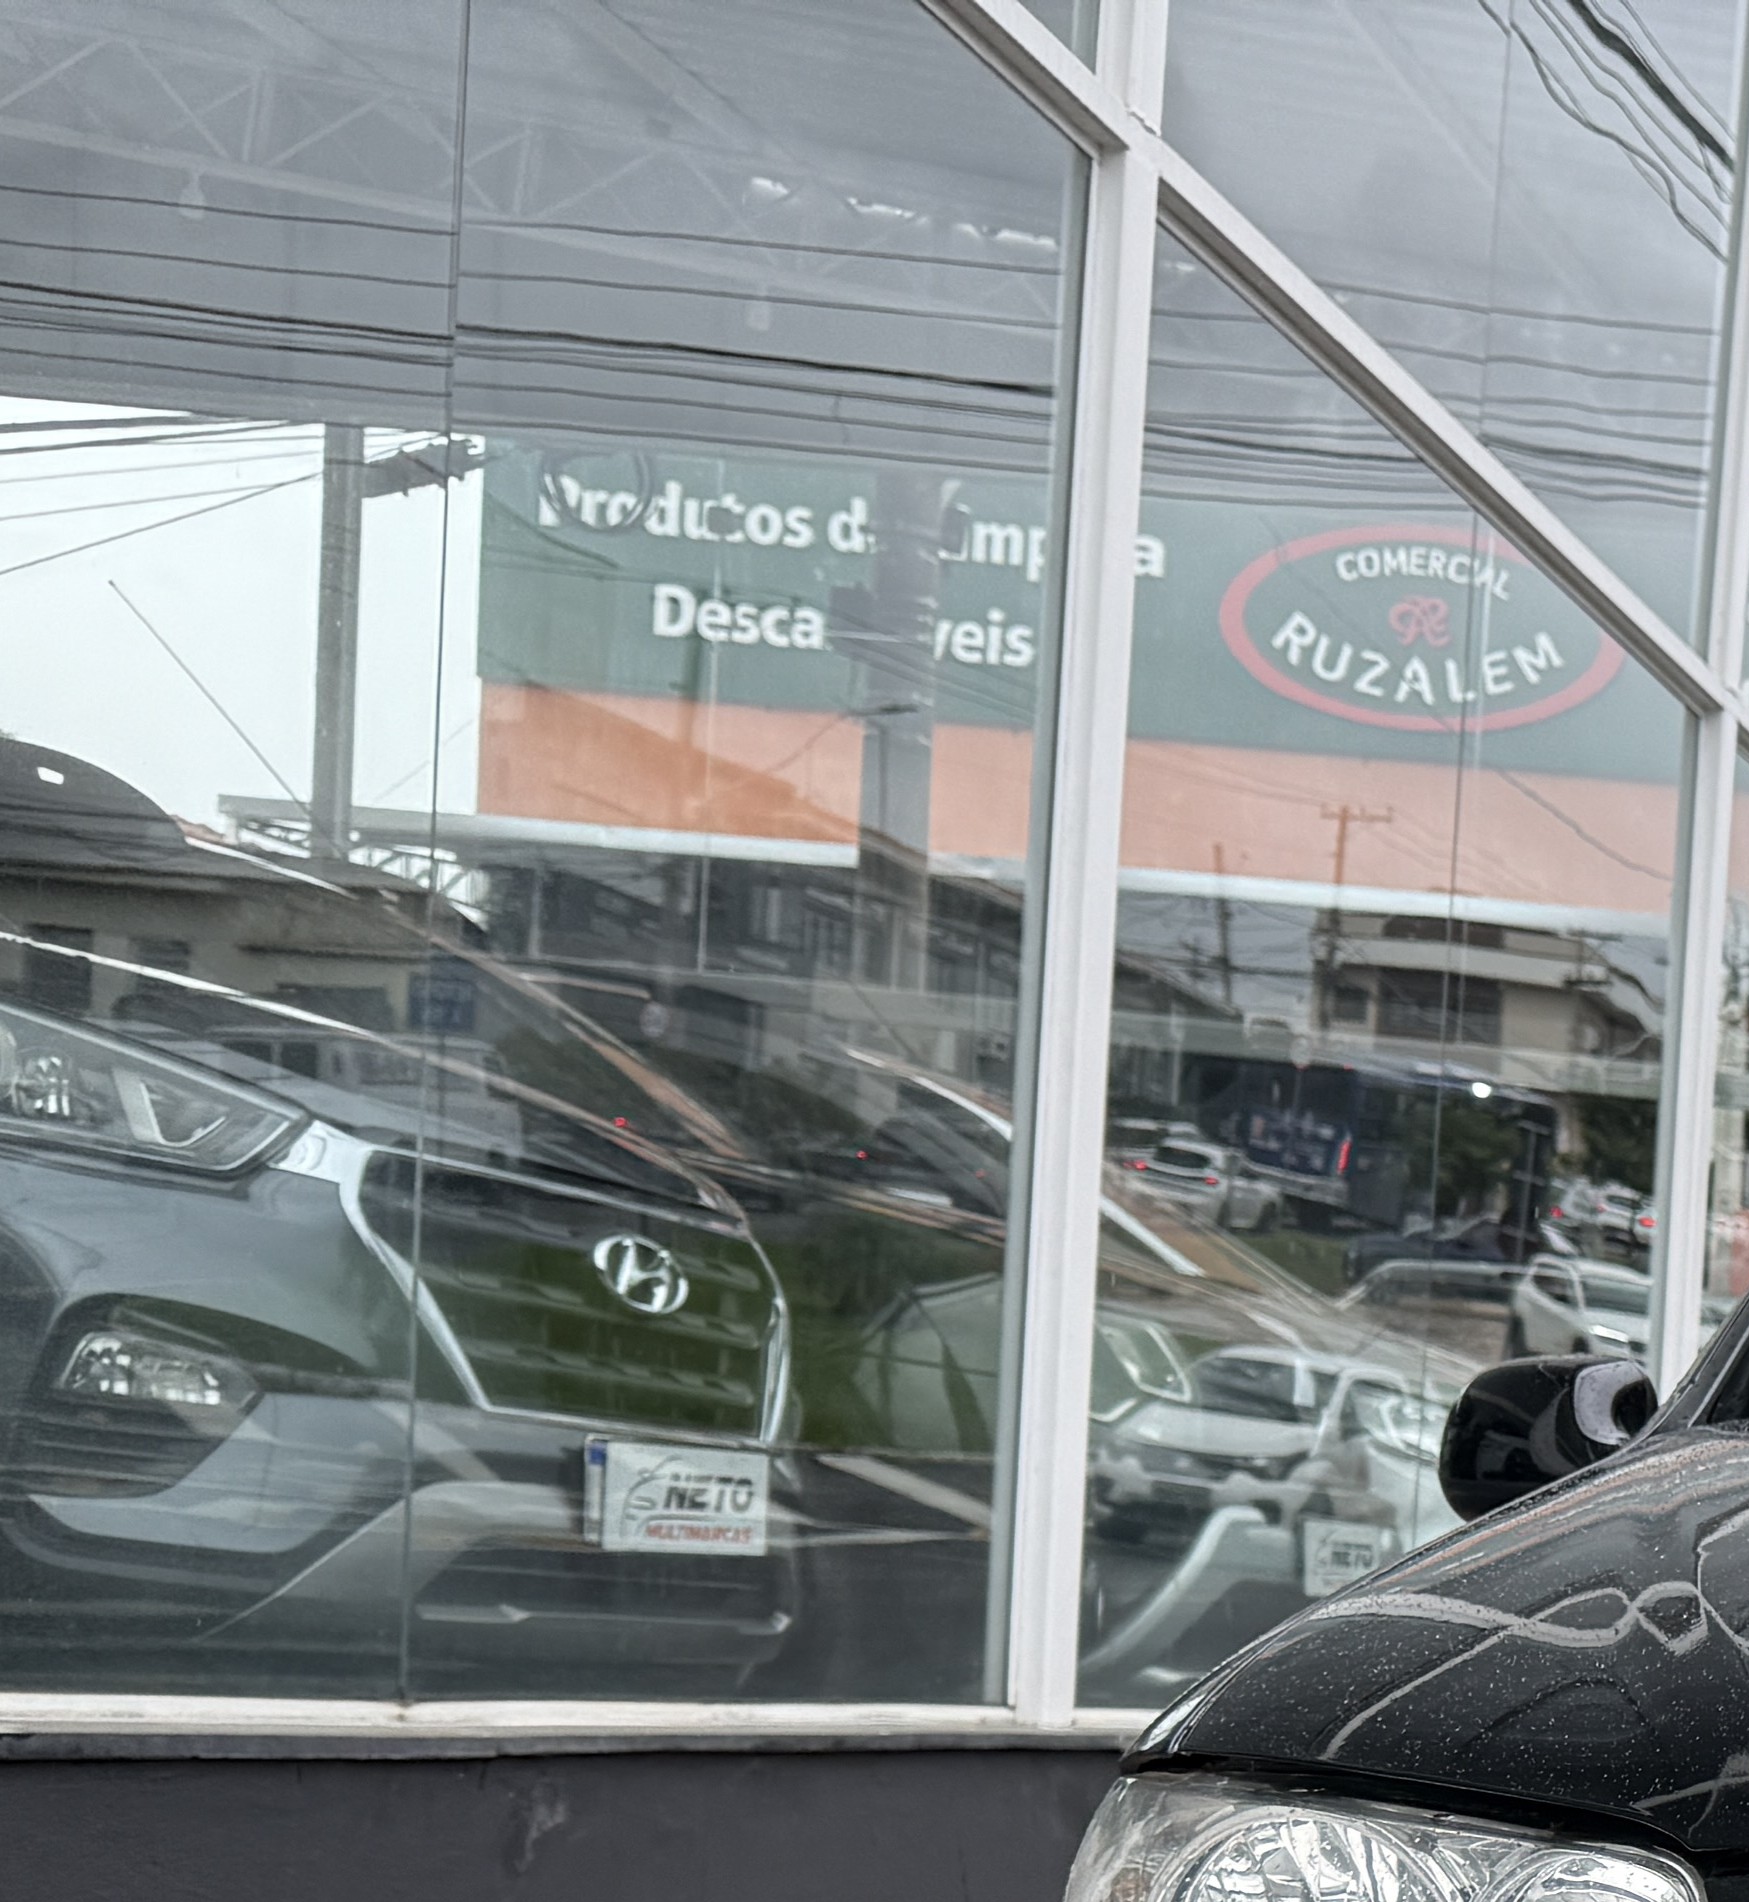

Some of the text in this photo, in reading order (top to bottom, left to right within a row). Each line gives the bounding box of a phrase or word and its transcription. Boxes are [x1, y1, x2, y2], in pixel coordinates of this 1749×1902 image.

[827, 496, 878, 554] d
[1335, 545, 1511, 600] COMERCIAL
[1271, 610, 1566, 706] RUZALEM
[663, 1472, 755, 1514] NETO
